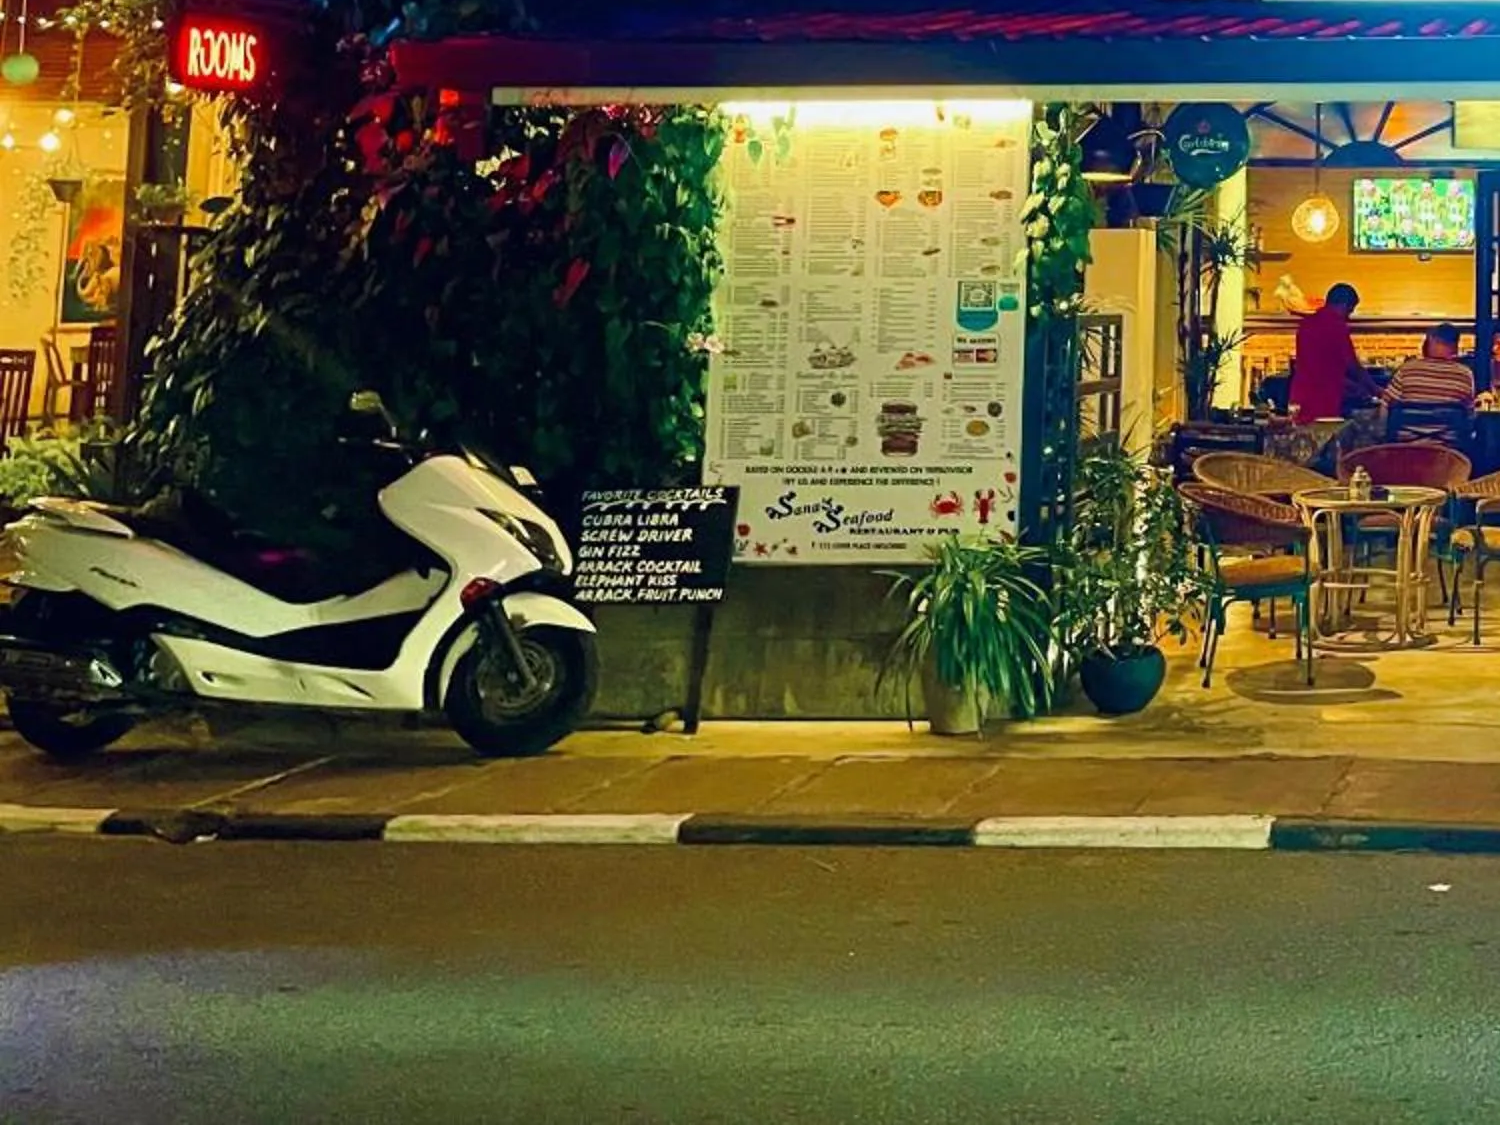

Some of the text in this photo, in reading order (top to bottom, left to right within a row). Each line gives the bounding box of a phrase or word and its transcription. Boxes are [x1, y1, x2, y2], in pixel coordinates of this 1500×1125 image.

[188, 27, 257, 81] ROOMS
[582, 487, 725, 502] FAVORITE COCKTAILS
[812, 503, 894, 534] Seafood
[580, 528, 693, 543] SCREW DRIVER
[578, 545, 642, 559] GIN FIZZ
[575, 559, 703, 574] ARRACK COCKTAIL
[574, 574, 678, 588] ELEPHANT KISS
[574, 587, 724, 601] ARRACK FRUIT PUNCH
